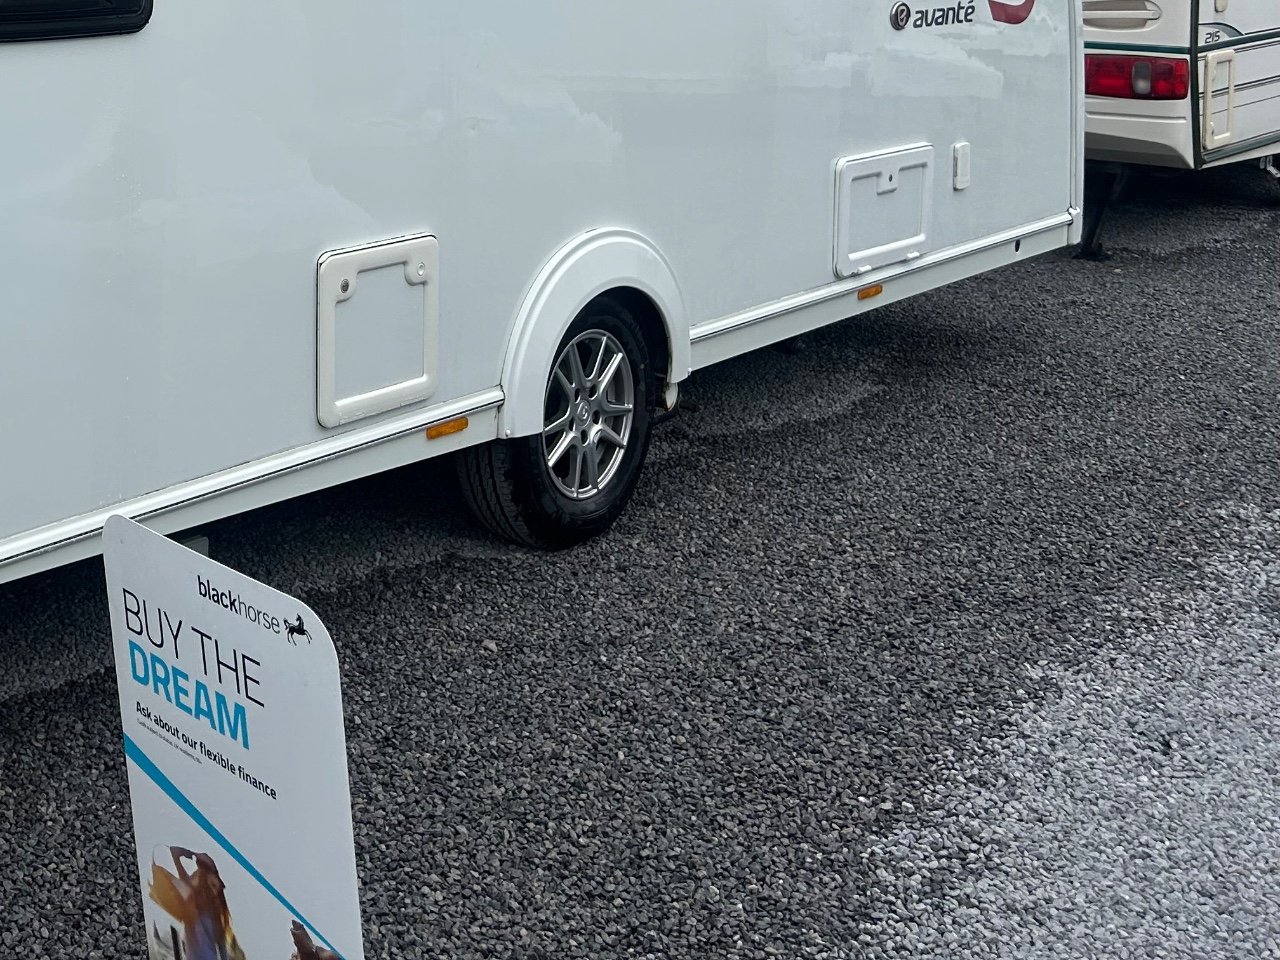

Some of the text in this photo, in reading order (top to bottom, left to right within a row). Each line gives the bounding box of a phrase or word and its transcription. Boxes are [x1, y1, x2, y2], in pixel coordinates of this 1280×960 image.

[913, 0, 975, 28] avanté
[123, 588, 264, 708] BUY THE
[197, 575, 280, 634] blackhorse
[128, 639, 249, 750] DREAM
[136, 701, 152, 721] Ask
[153, 715, 180, 740] about
[181, 733, 197, 750] our
[199, 741, 236, 775] flexible
[238, 765, 277, 800] finance
